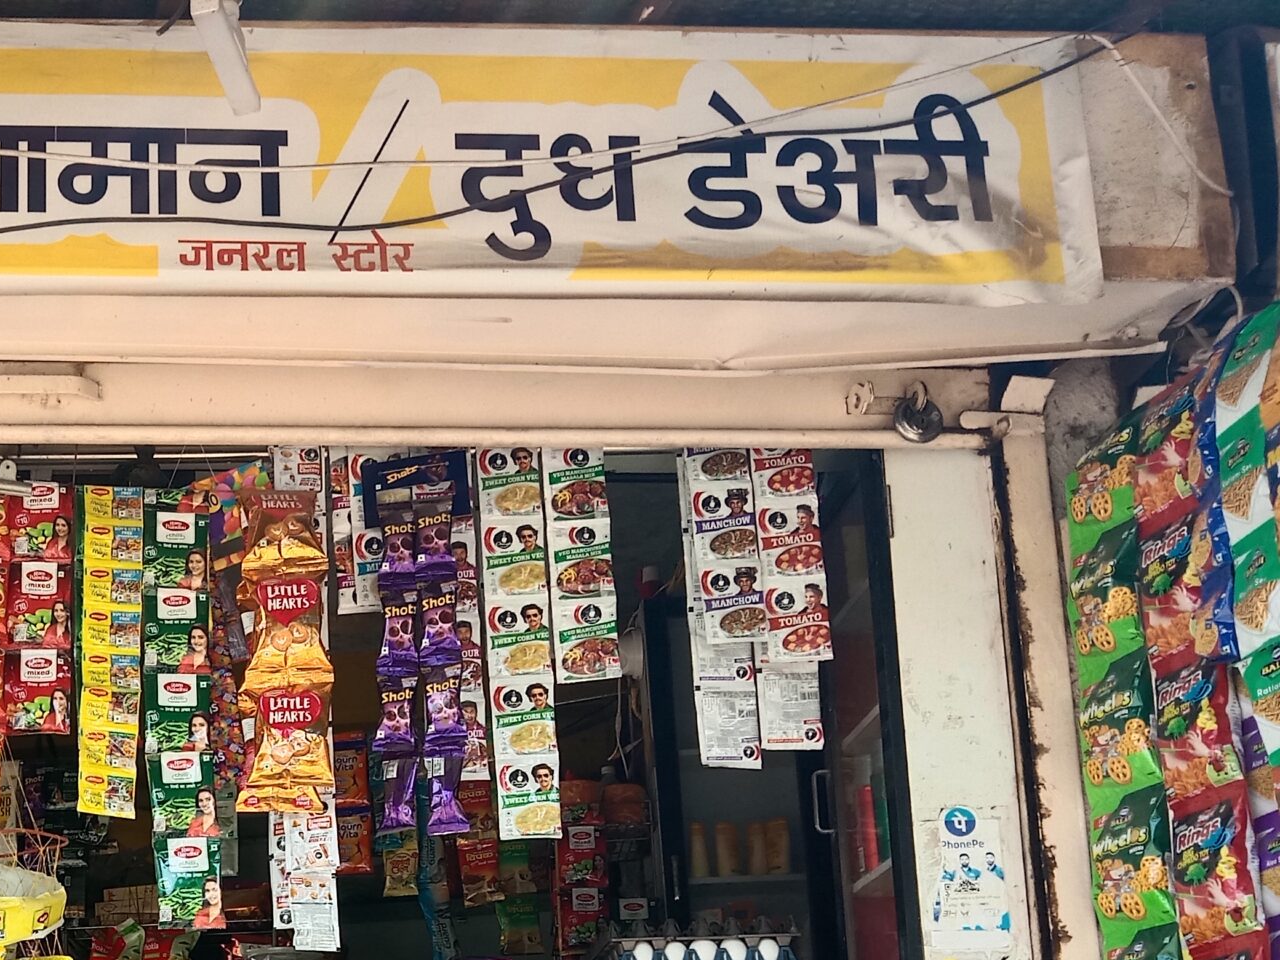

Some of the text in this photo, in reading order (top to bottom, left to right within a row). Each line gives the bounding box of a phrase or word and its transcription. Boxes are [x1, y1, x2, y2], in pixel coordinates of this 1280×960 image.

[454, 132, 638, 261] दुध
[684, 92, 989, 230] डेअरी
[178, 228, 414, 272] जनरल स्टोर
[764, 455, 806, 468] TOMATO
[702, 515, 751, 531] MANCHOW
[771, 533, 814, 547] TOMATO
[267, 584, 308, 599] LITTLE
[267, 597, 310, 611] HEARTS
[711, 594, 761, 608] MANCHOW
[779, 613, 822, 627] TOMATO
[270, 697, 311, 710] LITTLE
[269, 709, 312, 724] HEARTS
[1092, 827, 1149, 860] Wheelos
